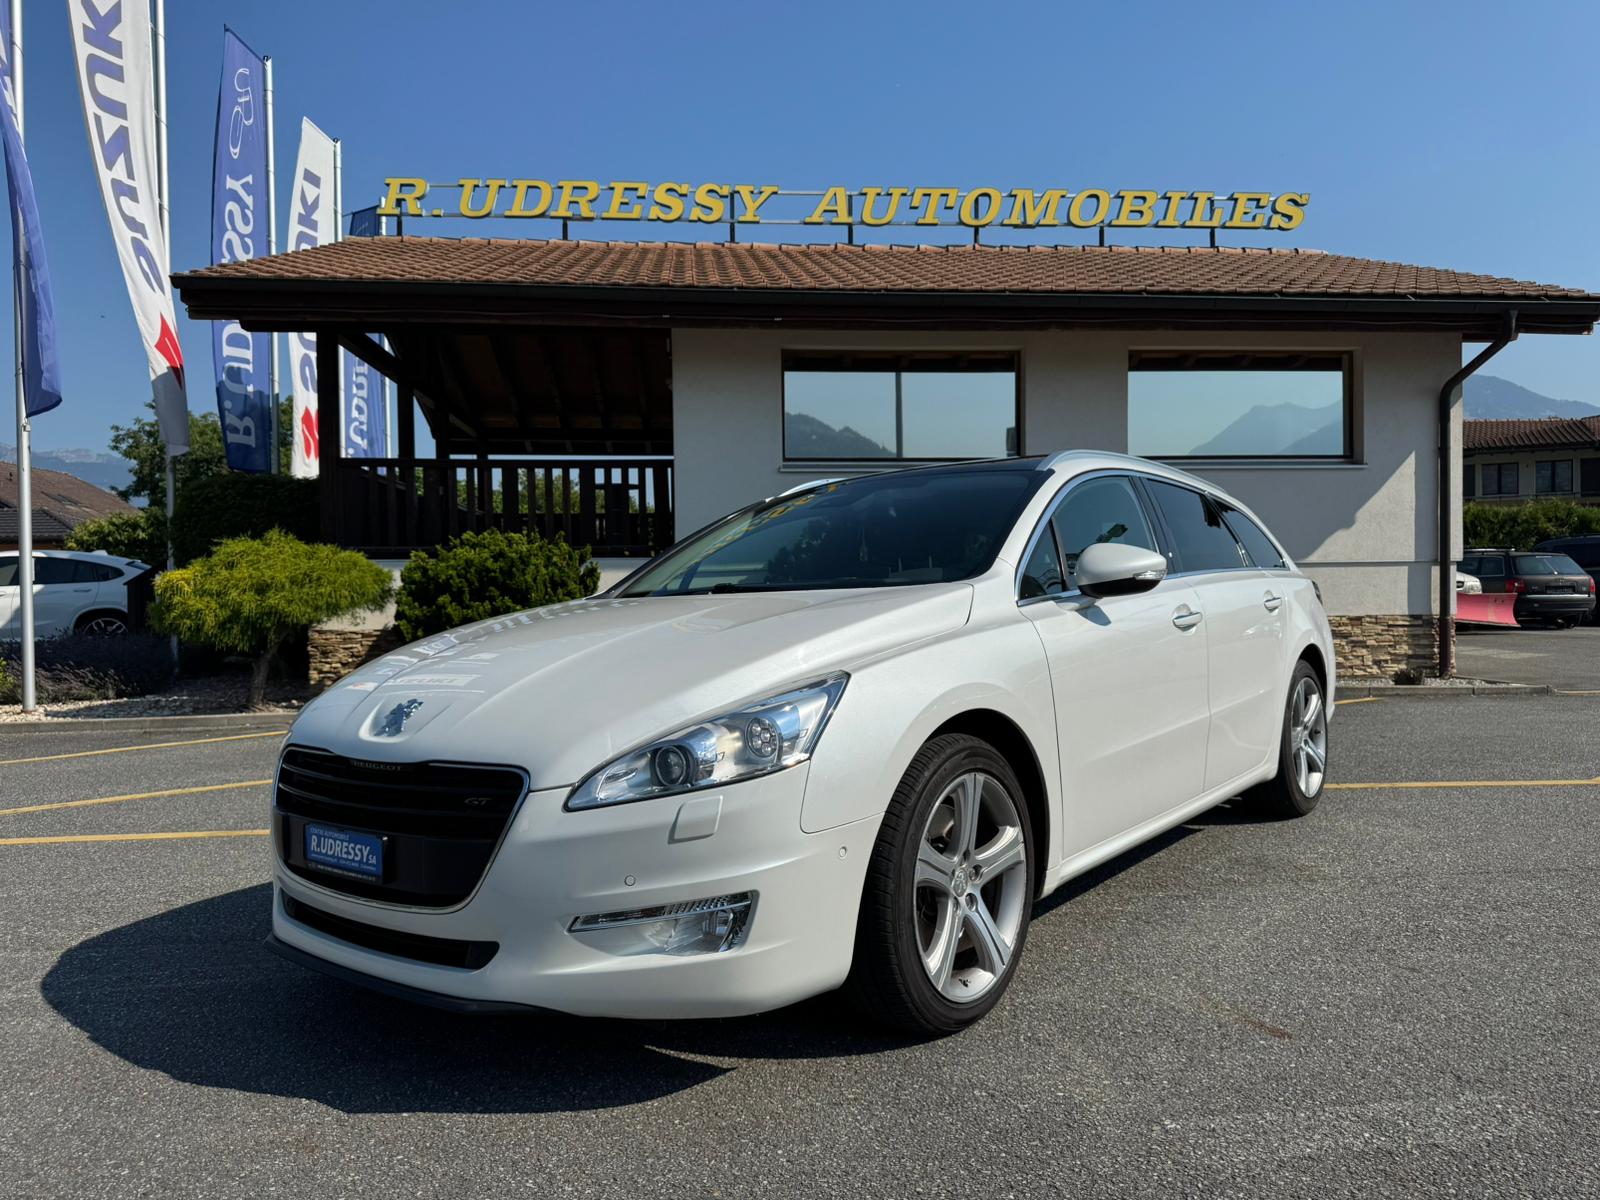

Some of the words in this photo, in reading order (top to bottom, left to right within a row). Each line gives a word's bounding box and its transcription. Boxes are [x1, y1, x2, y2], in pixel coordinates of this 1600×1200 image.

[457, 178, 779, 223] UDRESSY
[803, 186, 1312, 231] AUTOMOBILES
[463, 796, 493, 806] GT
[310, 834, 370, 863] R.UDRESSY
